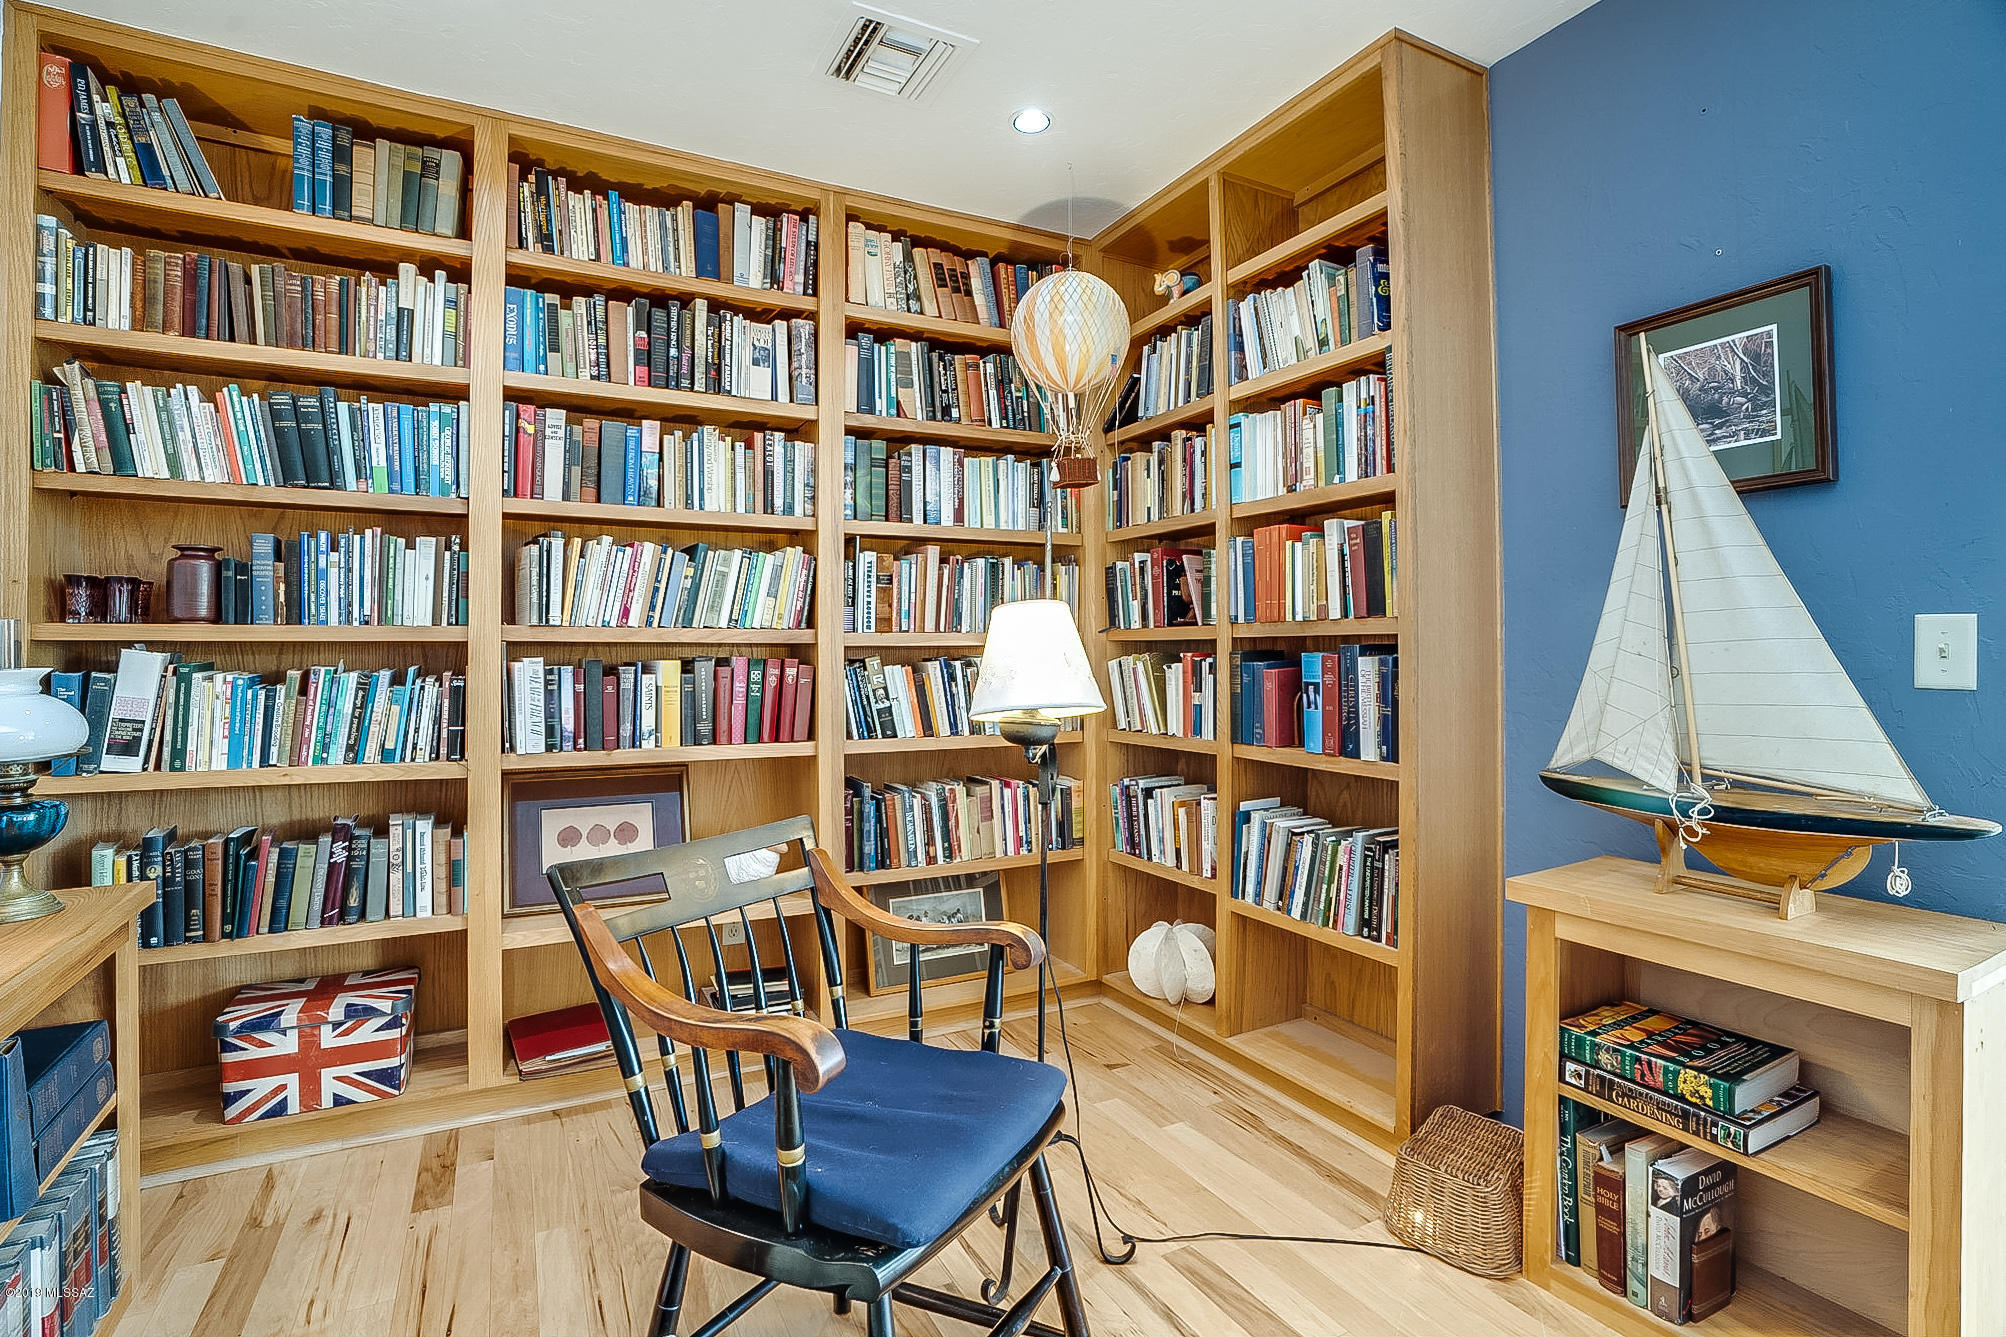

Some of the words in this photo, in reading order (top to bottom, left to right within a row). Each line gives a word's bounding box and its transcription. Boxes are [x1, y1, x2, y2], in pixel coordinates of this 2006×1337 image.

[77, 91, 90, 114] JAMES
[540, 209, 550, 234] Happened
[883, 240, 892, 266] GORKY
[505, 303, 519, 344] EXODUS
[670, 306, 680, 331] STEPHEN
[670, 332, 680, 347] KING
[71, 390, 87, 419] PUBLIC
[328, 397, 339, 445] PRESENCES
[78, 427, 98, 464] PRAYERS
[444, 426, 452, 453] GEORGE
[627, 437, 636, 449] FIRE
[765, 435, 774, 466] ZEALOT
[444, 454, 452, 485] HERBERT
[626, 468, 635, 496] HEAVEN
[799, 568, 808, 591] Religion
[529, 675, 542, 695] YEAR
[644, 682, 654, 710] SAINTS
[274, 701, 282, 722] Creative
[354, 691, 364, 708] design
[1347, 674, 1356, 731] CHRISTIAN
[319, 704, 327, 727] PREACHING
[530, 703, 544, 736] FRENCH
[271, 723, 280, 746] Brooding
[347, 719, 359, 745] preaching
[905, 811, 918, 851] INCARNATION
[174, 850, 182, 882] AUNTIE
[1371, 905, 1379, 928] DEATH
[1633, 1023, 1693, 1050] GARDEN
[1612, 1090, 1683, 1130] GARDENING
[1613, 1079, 1683, 1116] ENCYCLOPEDIA
[1562, 1136, 1571, 1156] The
[1562, 1157, 1573, 1196] Garden
[1698, 1170, 1722, 1190] DAVID
[1596, 1186, 1620, 1201] HOLY
[1596, 1196, 1620, 1211] BIBLE
[1563, 1197, 1575, 1224] Book
